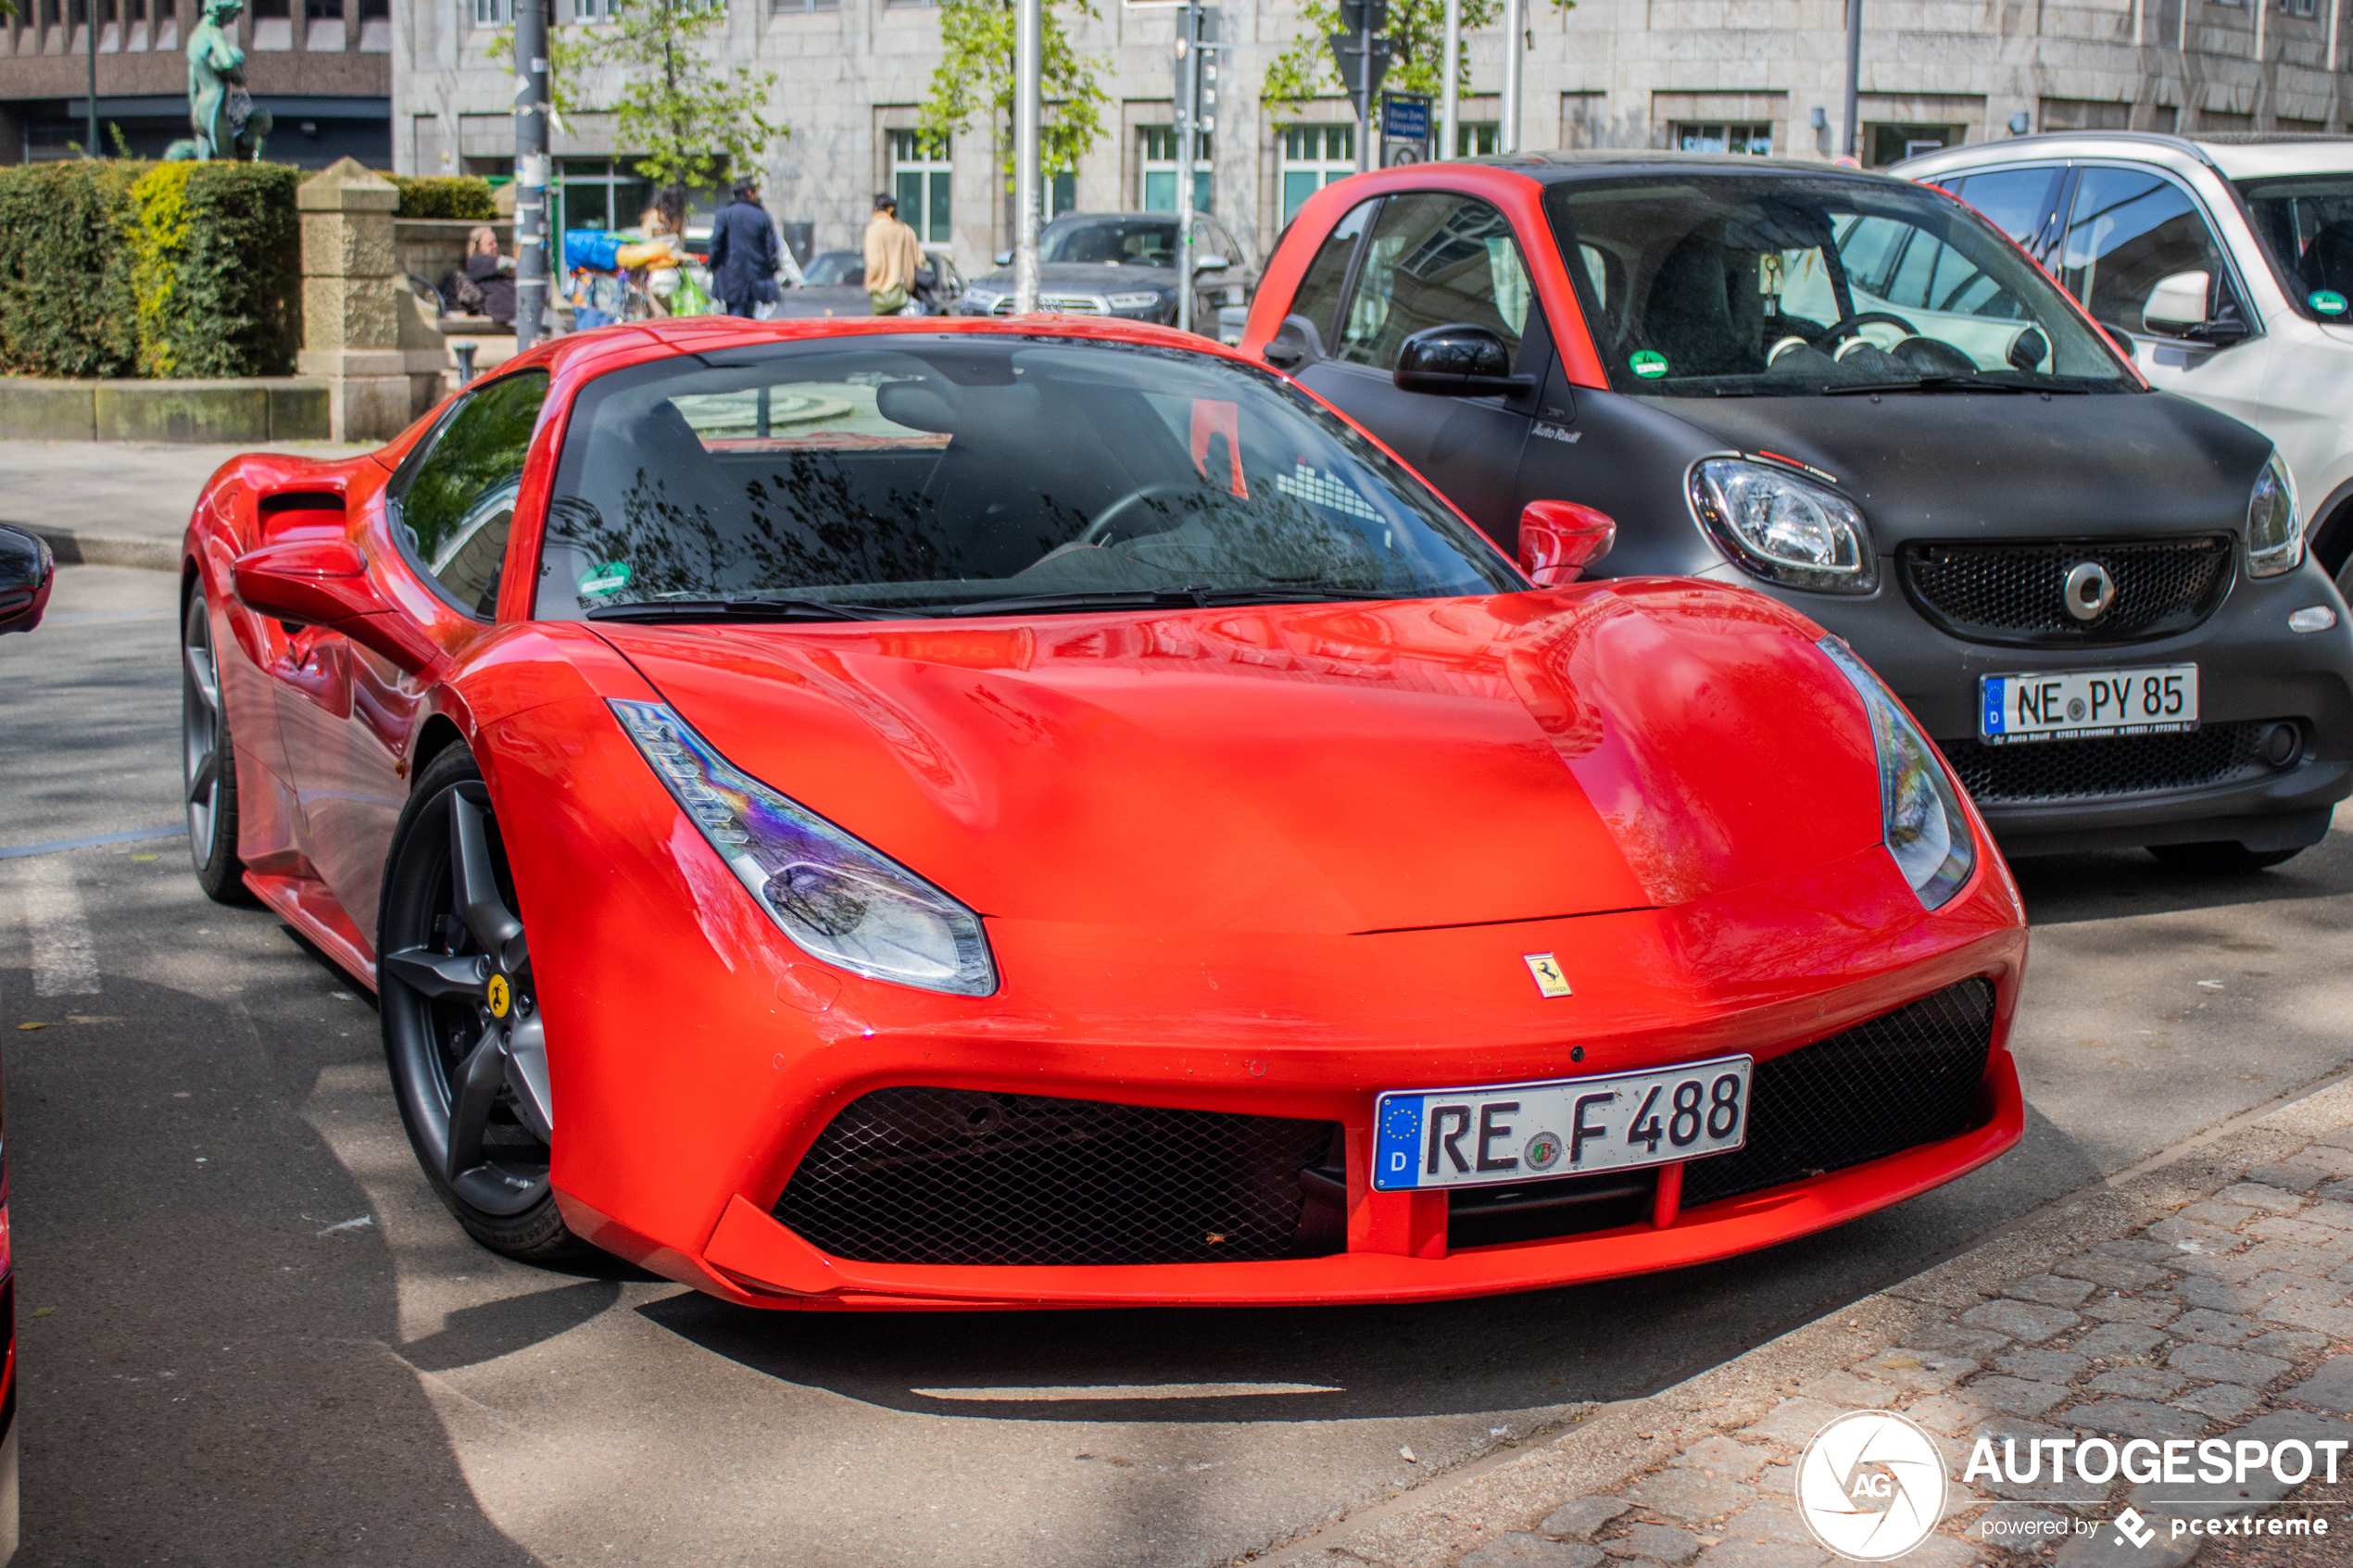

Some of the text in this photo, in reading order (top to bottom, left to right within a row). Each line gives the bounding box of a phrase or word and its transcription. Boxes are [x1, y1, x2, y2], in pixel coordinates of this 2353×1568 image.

[1409, 109, 1425, 120] Zone
[1390, 121, 1425, 135] Königsallee
[1531, 422, 1554, 439] Auto
[2018, 684, 2064, 724] NE
[2088, 678, 2132, 721] PY
[2143, 676, 2183, 715] 85
[1991, 711, 1999, 724] D
[2007, 734, 2027, 743] Auto
[1427, 1073, 1741, 1174] RE F 488
[1391, 1152, 1406, 1173] D
